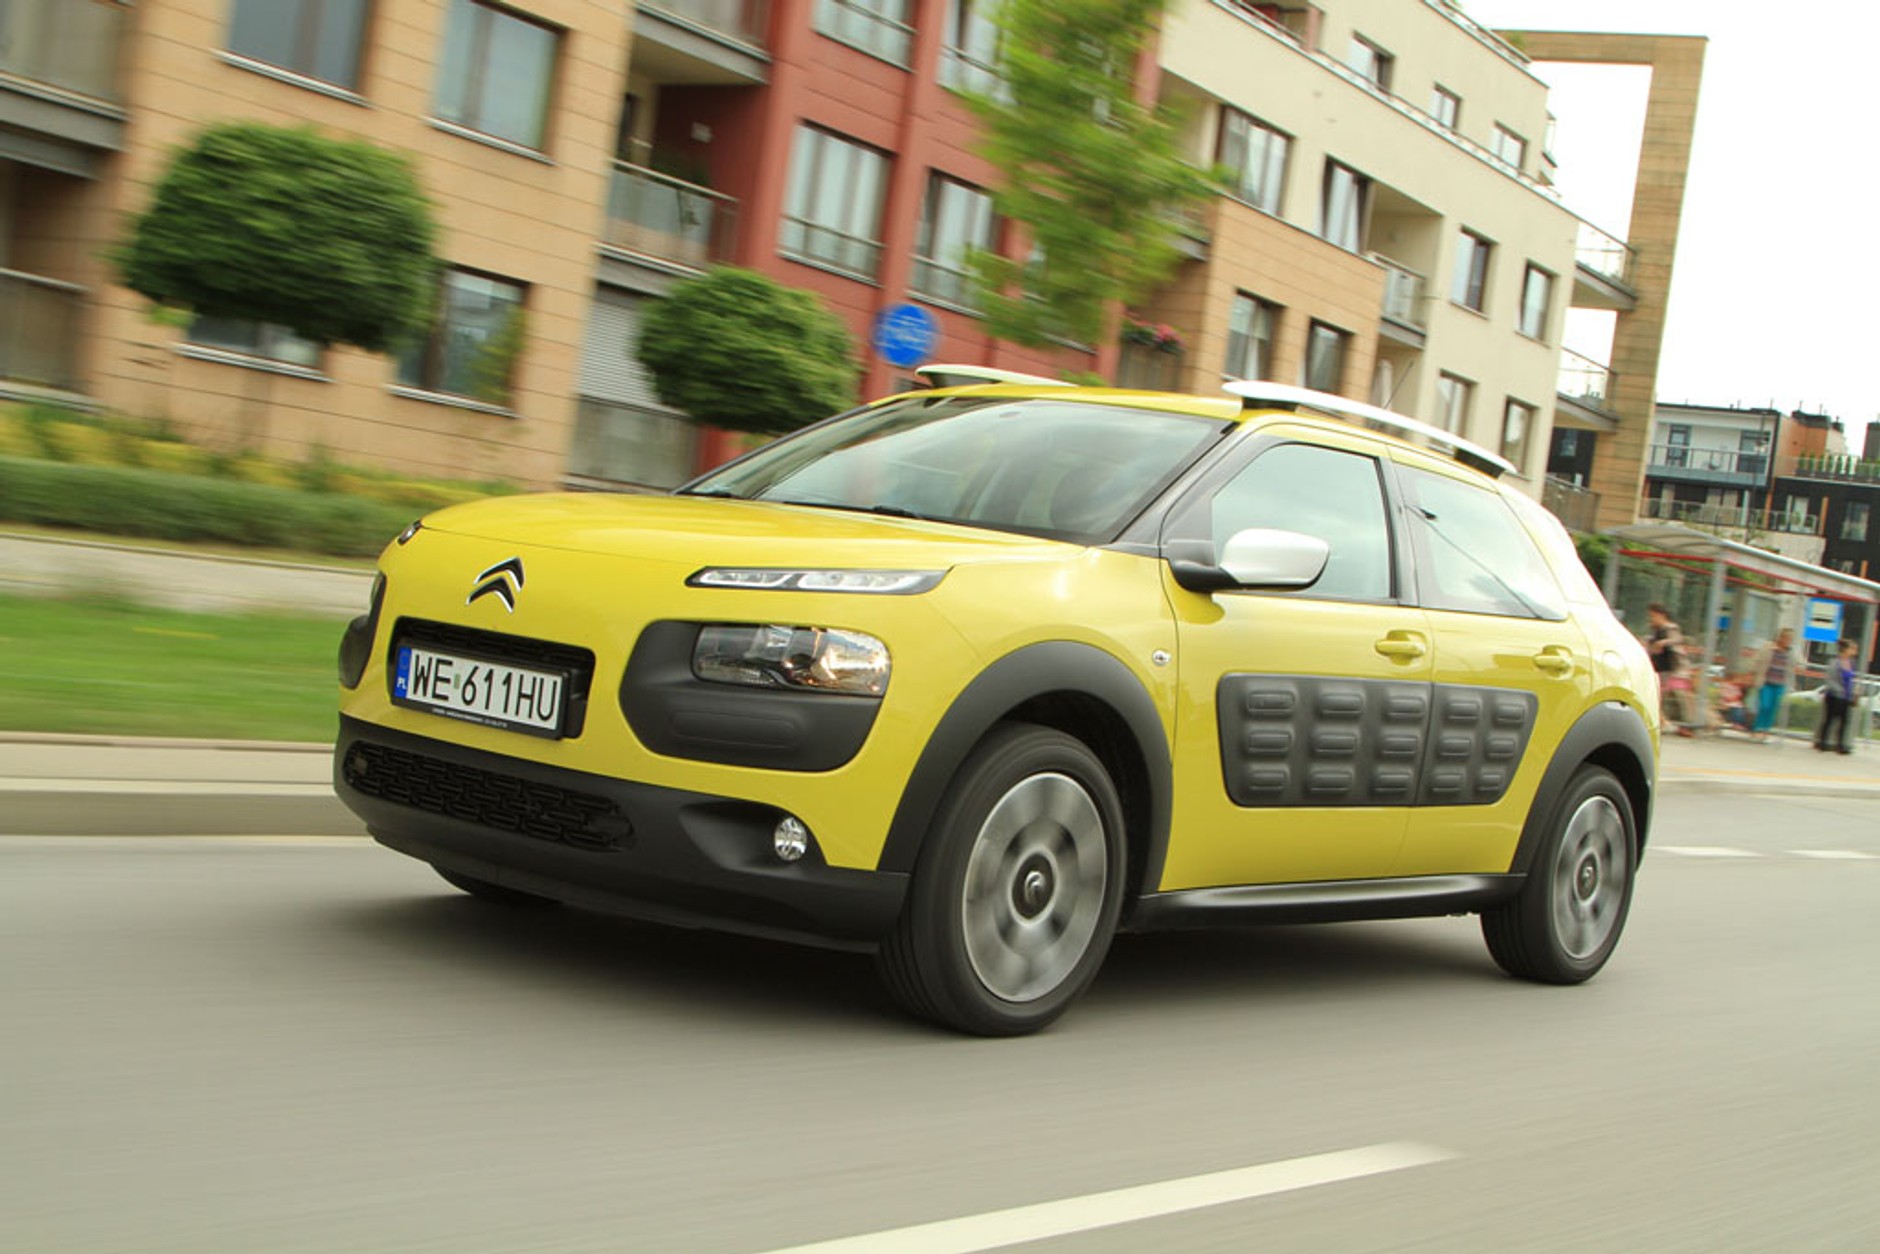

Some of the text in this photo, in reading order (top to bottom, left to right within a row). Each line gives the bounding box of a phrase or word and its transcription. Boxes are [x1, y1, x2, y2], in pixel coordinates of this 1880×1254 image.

[396, 677, 408, 690] PL
[413, 654, 453, 702] WE
[461, 665, 558, 721] 611HU
